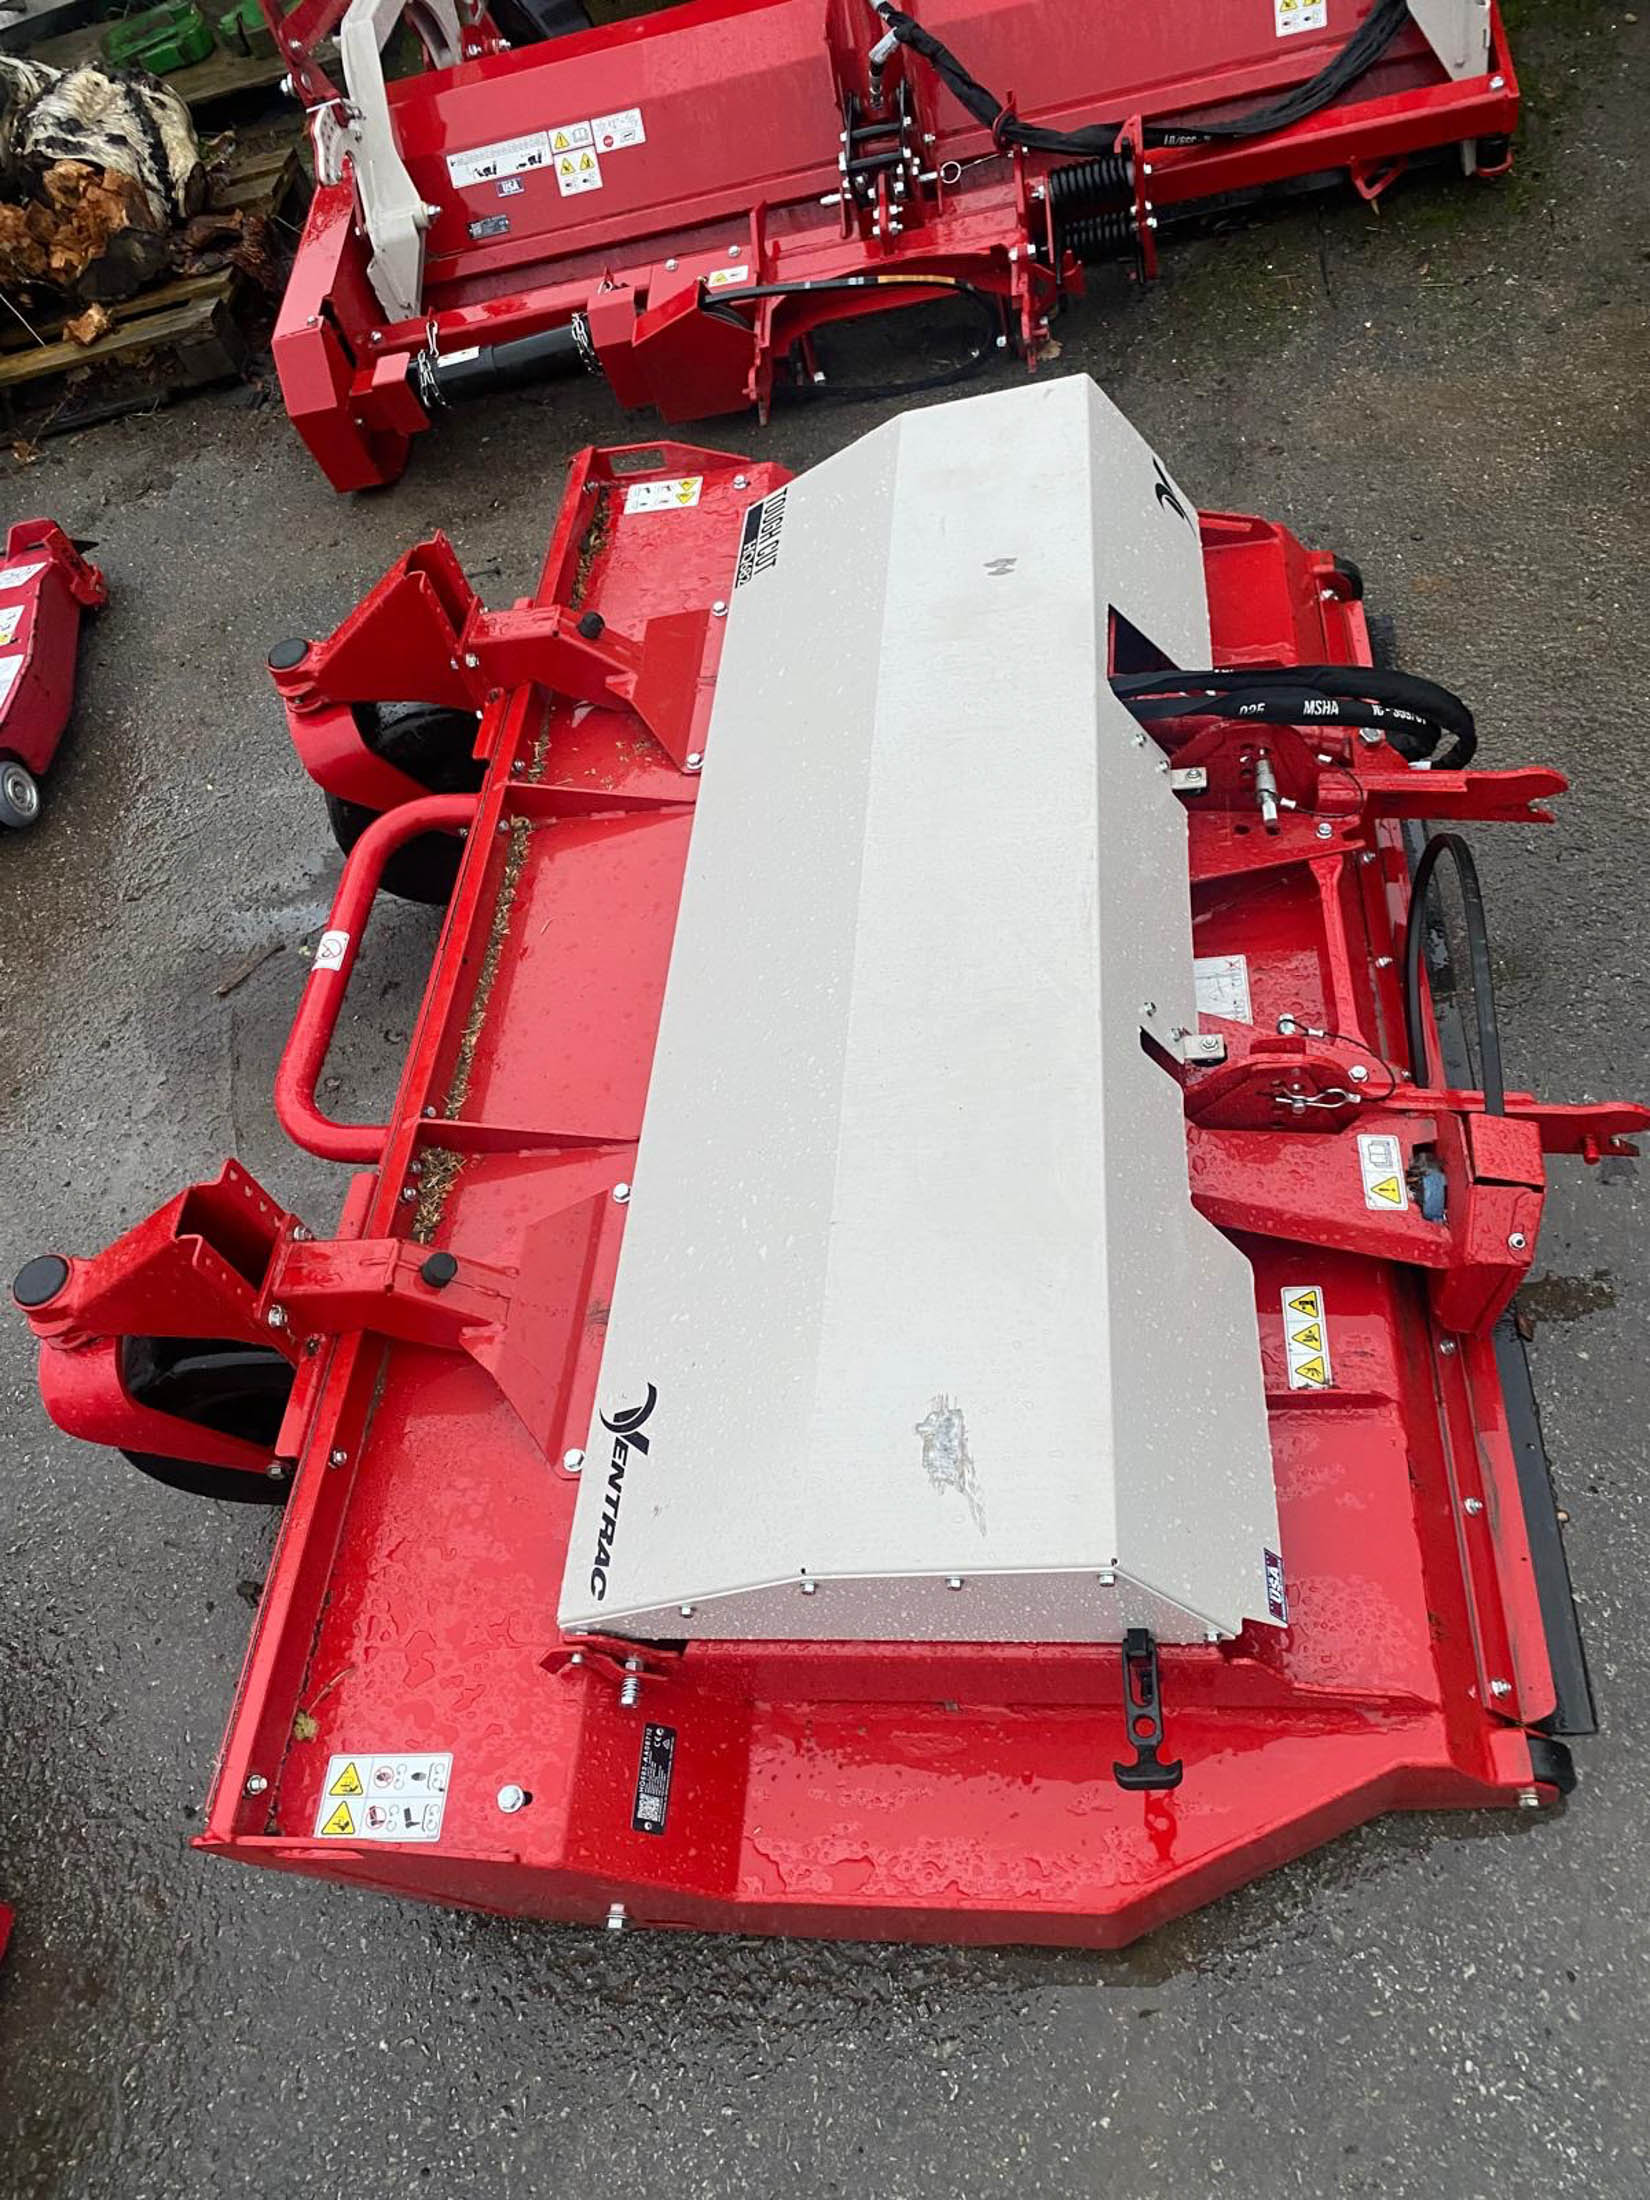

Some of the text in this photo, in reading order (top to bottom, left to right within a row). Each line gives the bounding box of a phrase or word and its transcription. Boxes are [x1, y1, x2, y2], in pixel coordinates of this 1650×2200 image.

[753, 487, 788, 576] TOUGH CUT
[1302, 700, 1340, 716] MSHA
[590, 1382, 657, 1601] VENTRAC
[1266, 1566, 1284, 1605] USA
